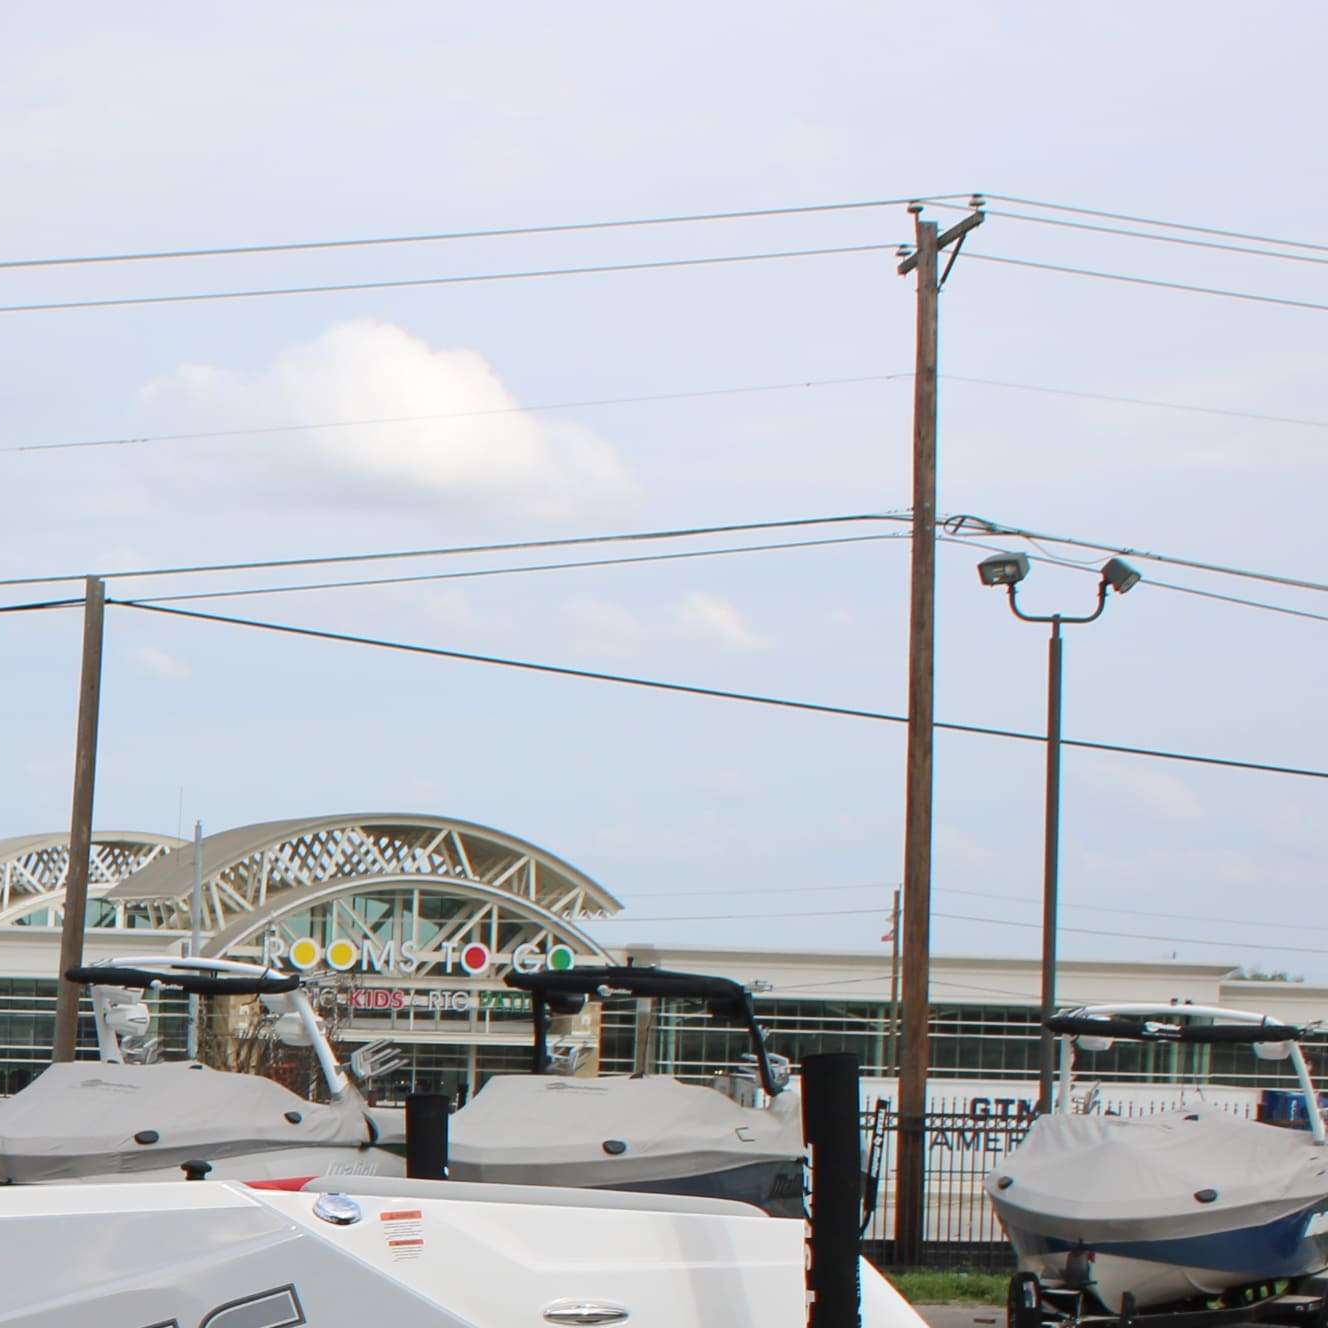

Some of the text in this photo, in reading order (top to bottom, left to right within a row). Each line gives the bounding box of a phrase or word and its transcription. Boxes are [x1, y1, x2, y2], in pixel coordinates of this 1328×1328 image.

[264, 937, 575, 974] ROOMS TO GO
[350, 989, 404, 1009] KIDS
